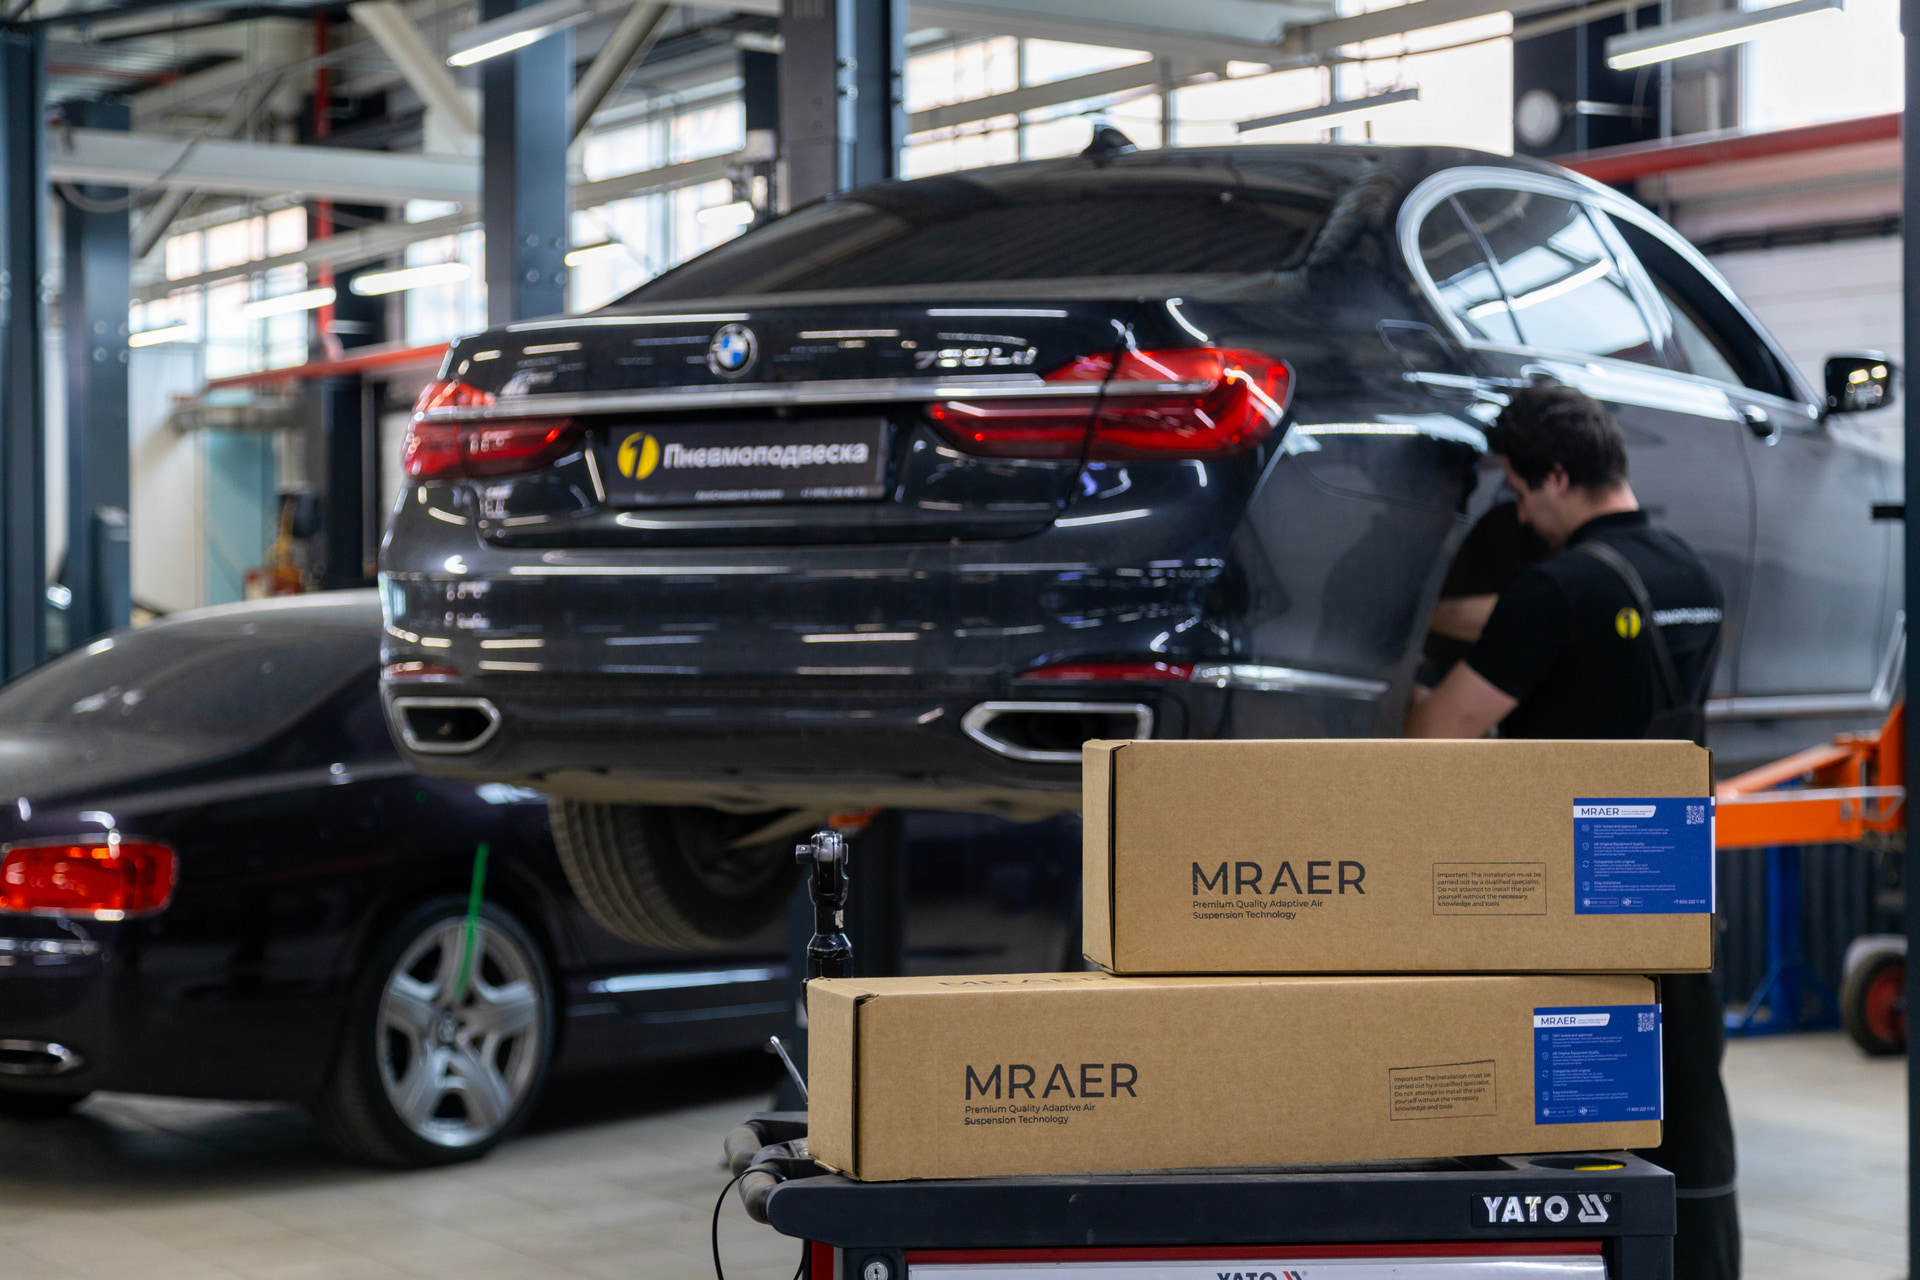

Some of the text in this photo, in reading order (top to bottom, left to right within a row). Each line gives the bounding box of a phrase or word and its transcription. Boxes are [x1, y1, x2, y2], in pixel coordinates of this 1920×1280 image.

[663, 443, 869, 468] Пневмоподвеска
[1581, 808, 1619, 816] MRAER
[1192, 861, 1366, 895] MRAER
[1193, 899, 1323, 909] Premium Quality Adaptive Air
[1193, 910, 1296, 920] Suspension Technology
[965, 1063, 1138, 1100] MRAER
[965, 1103, 1095, 1113] Premium Quality Adaptive Air
[965, 1115, 1069, 1125] Suspension Technology
[1483, 1196, 1569, 1222] YATO
